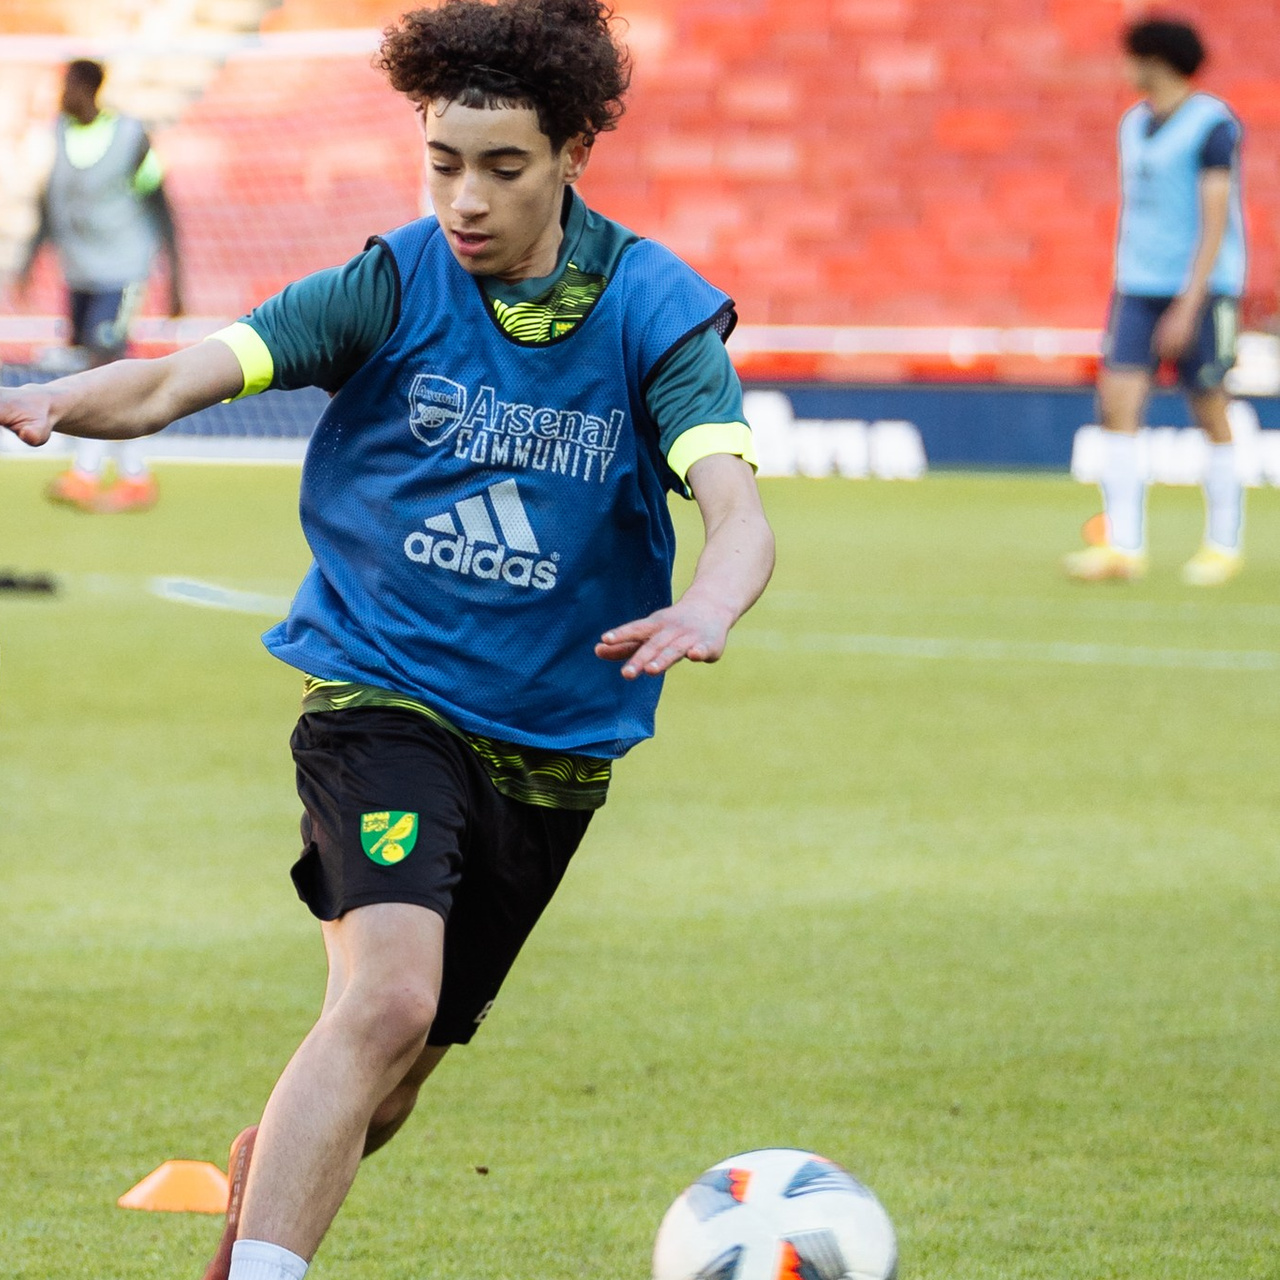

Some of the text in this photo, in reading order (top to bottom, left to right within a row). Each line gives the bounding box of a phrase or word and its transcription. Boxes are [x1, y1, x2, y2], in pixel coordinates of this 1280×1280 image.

[463, 385, 625, 452] Arsenal
[454, 427, 615, 483] COMMUNITY
[403, 531, 558, 590] adidas
